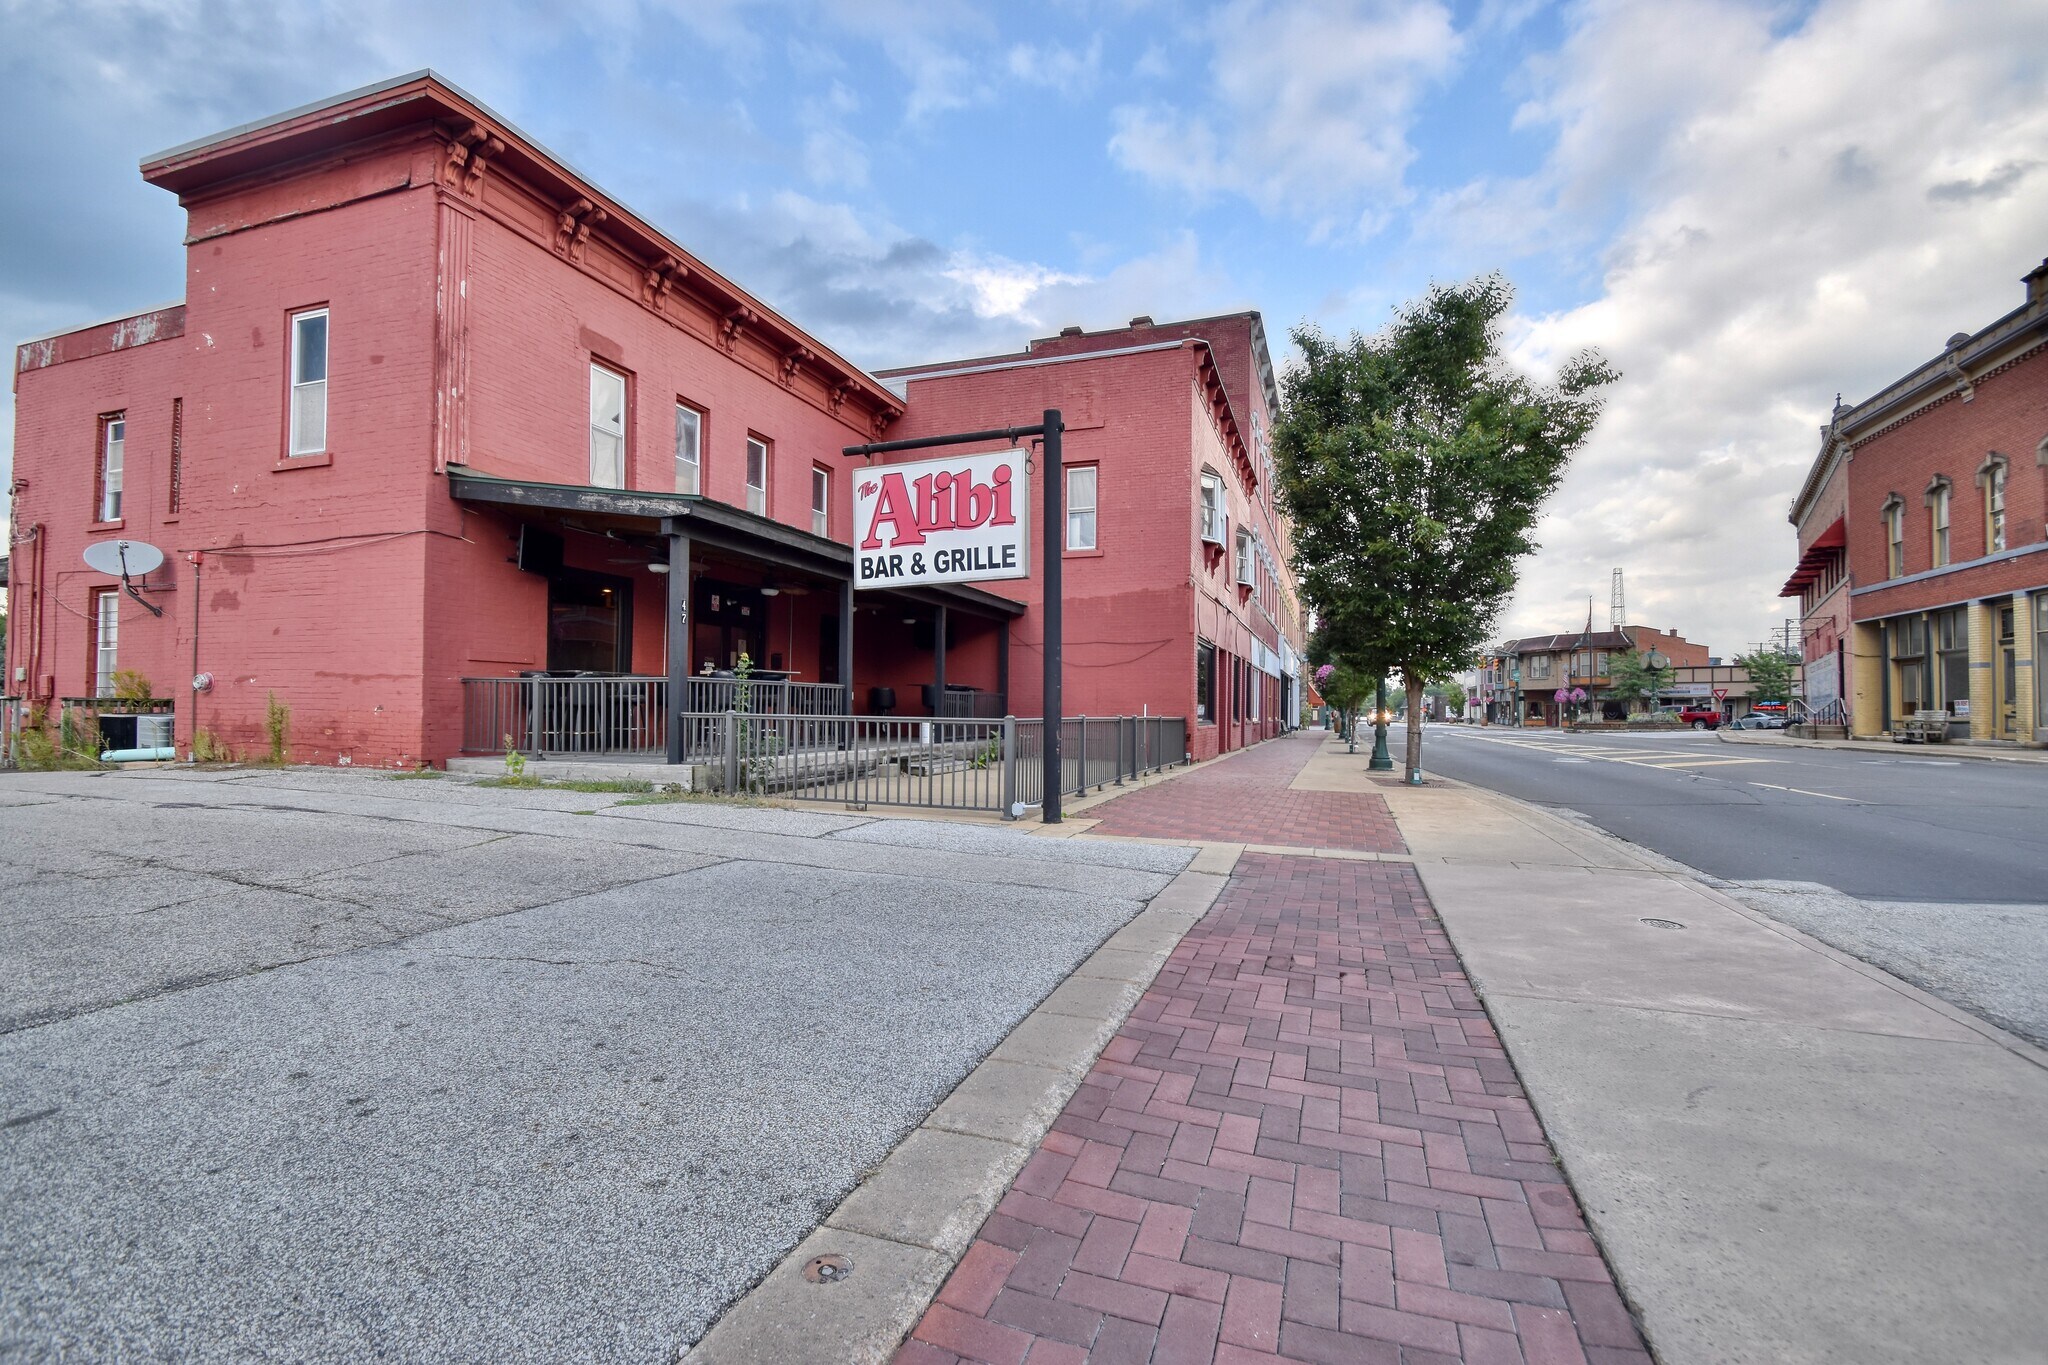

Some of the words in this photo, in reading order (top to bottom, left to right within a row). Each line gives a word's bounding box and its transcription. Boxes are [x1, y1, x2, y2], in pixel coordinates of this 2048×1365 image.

[857, 480, 878, 501] The
[860, 464, 1016, 551] Alibi
[860, 554, 904, 580] BAR
[910, 552, 927, 576] &
[933, 544, 1017, 574] GRILLE
